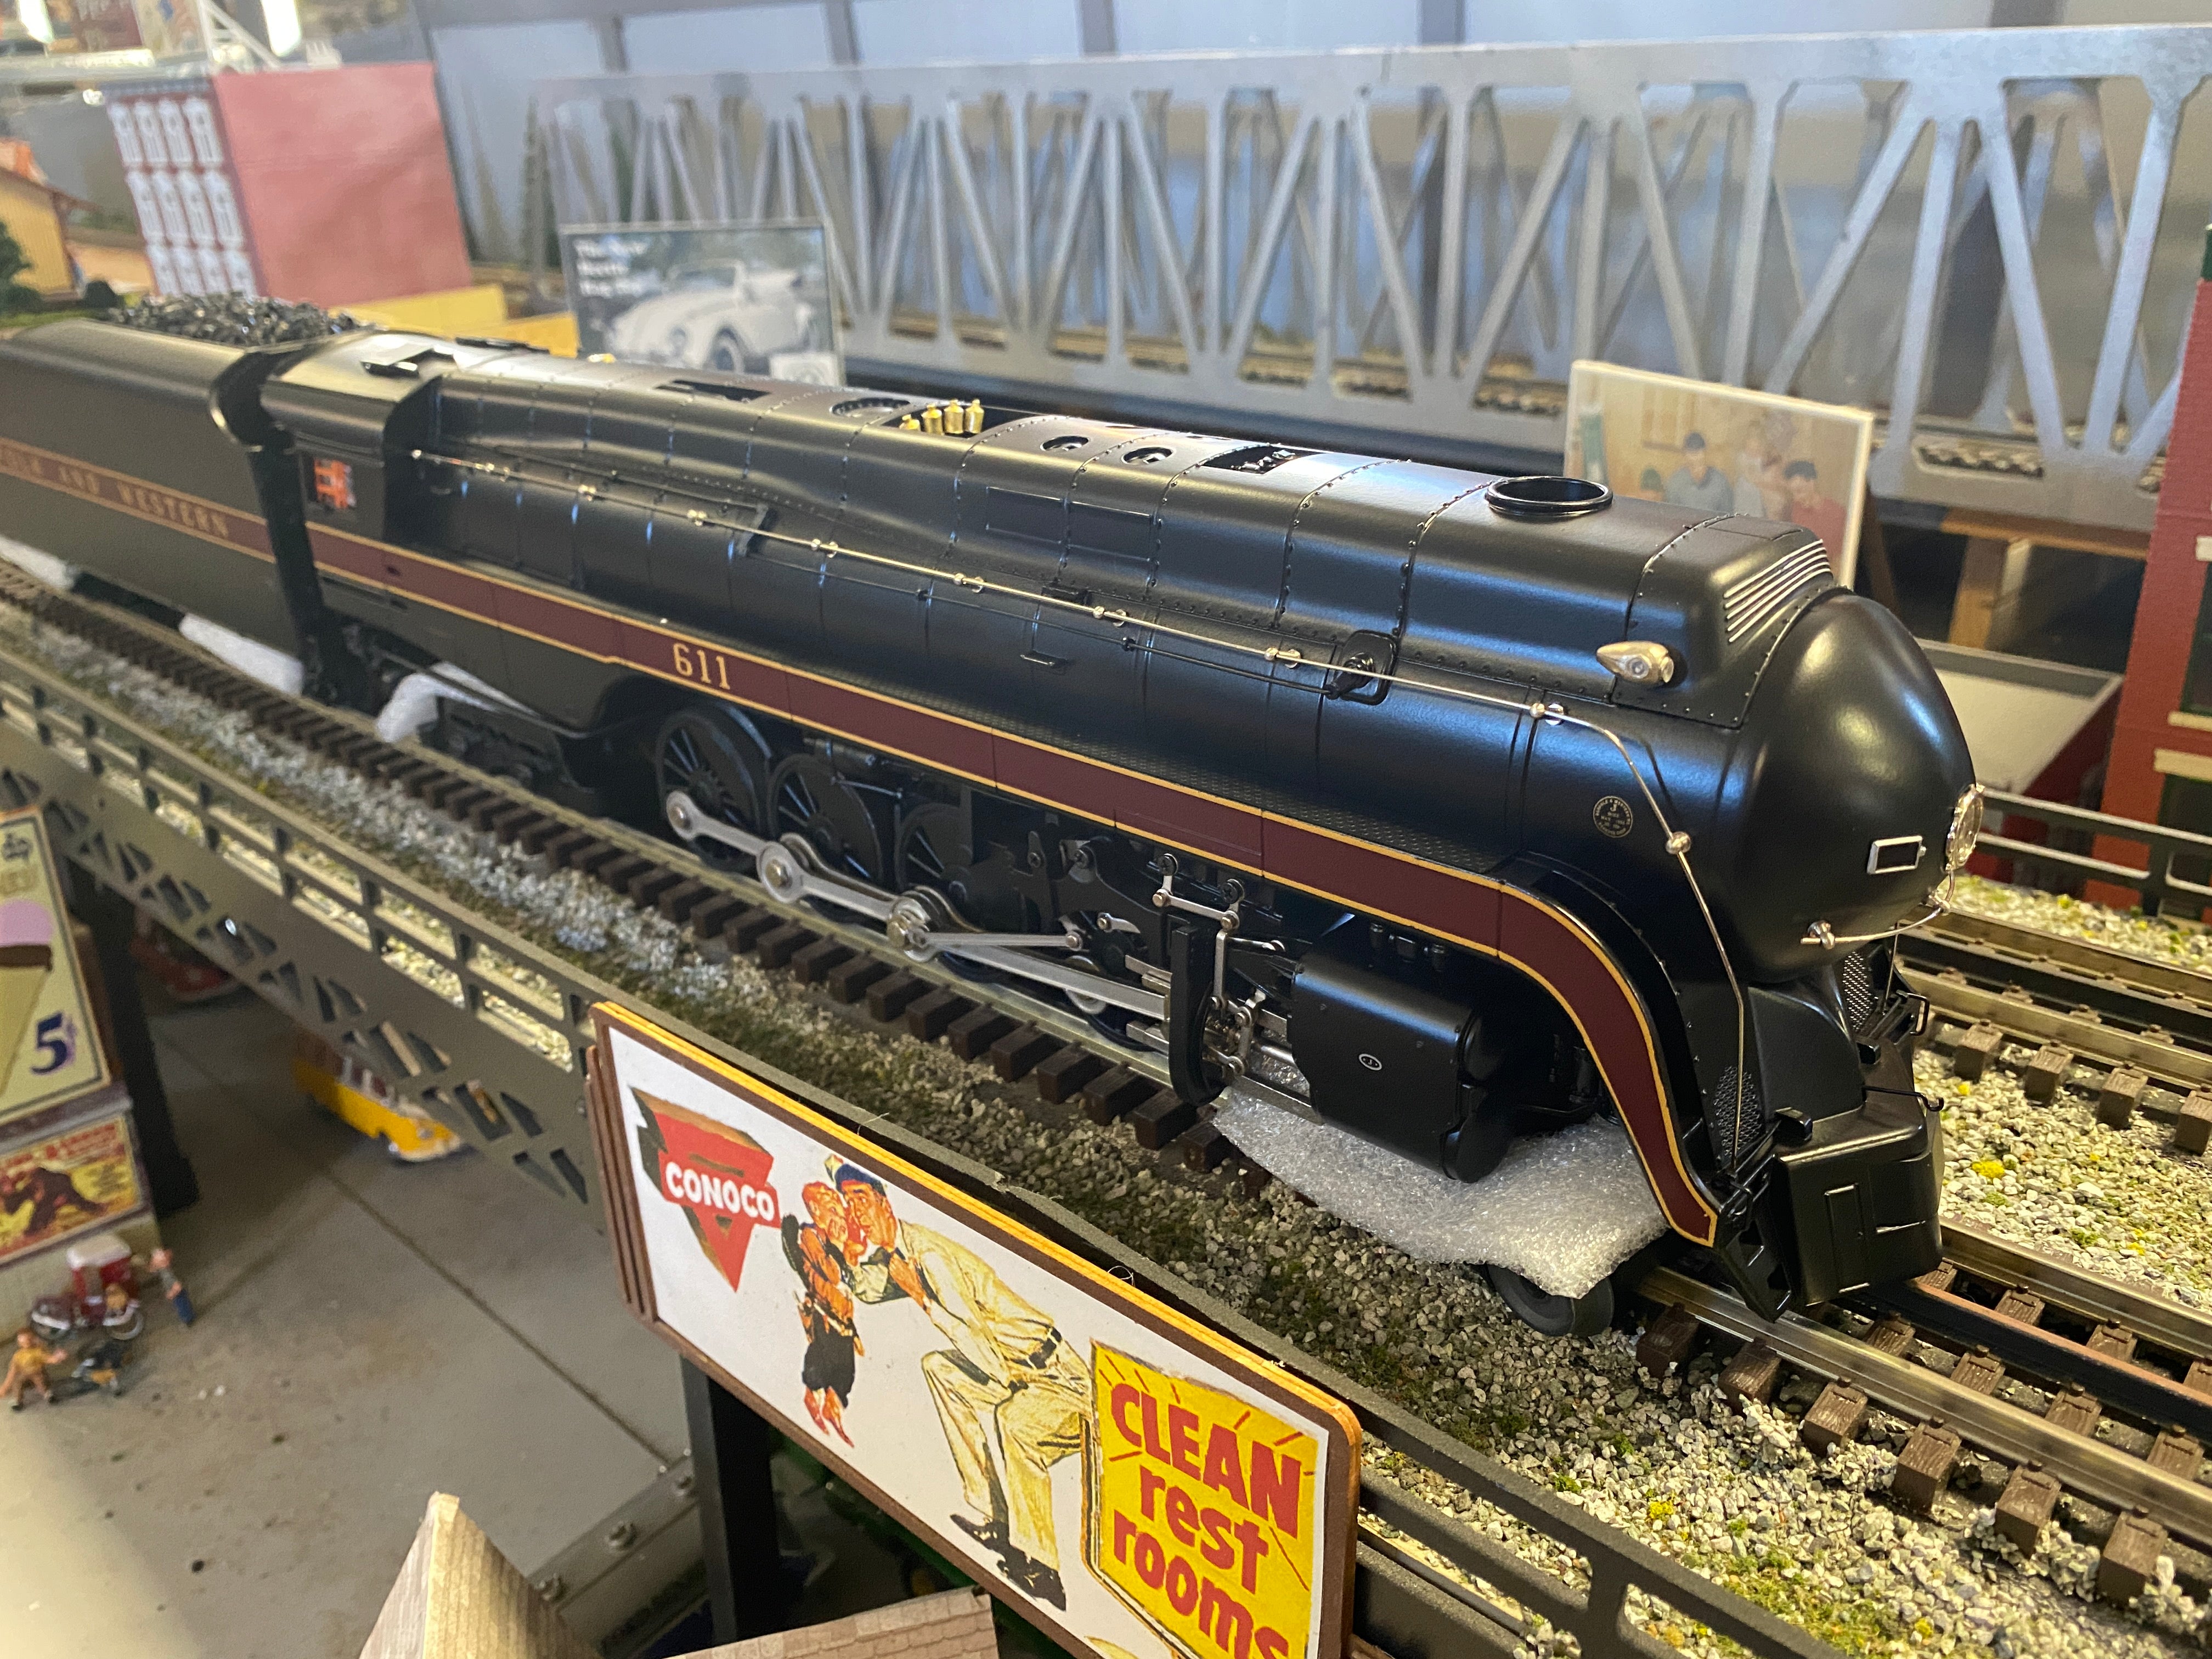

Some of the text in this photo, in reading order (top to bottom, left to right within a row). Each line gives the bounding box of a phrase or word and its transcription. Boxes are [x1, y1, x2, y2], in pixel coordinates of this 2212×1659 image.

[673, 642, 731, 690] 611
[1610, 804, 1617, 812] J
[31, 1012, 67, 1075] 5
[665, 1161, 776, 1222] CONOCO
[1111, 1383, 1302, 1540] CLEAN
[1140, 1464, 1269, 1595] rest
